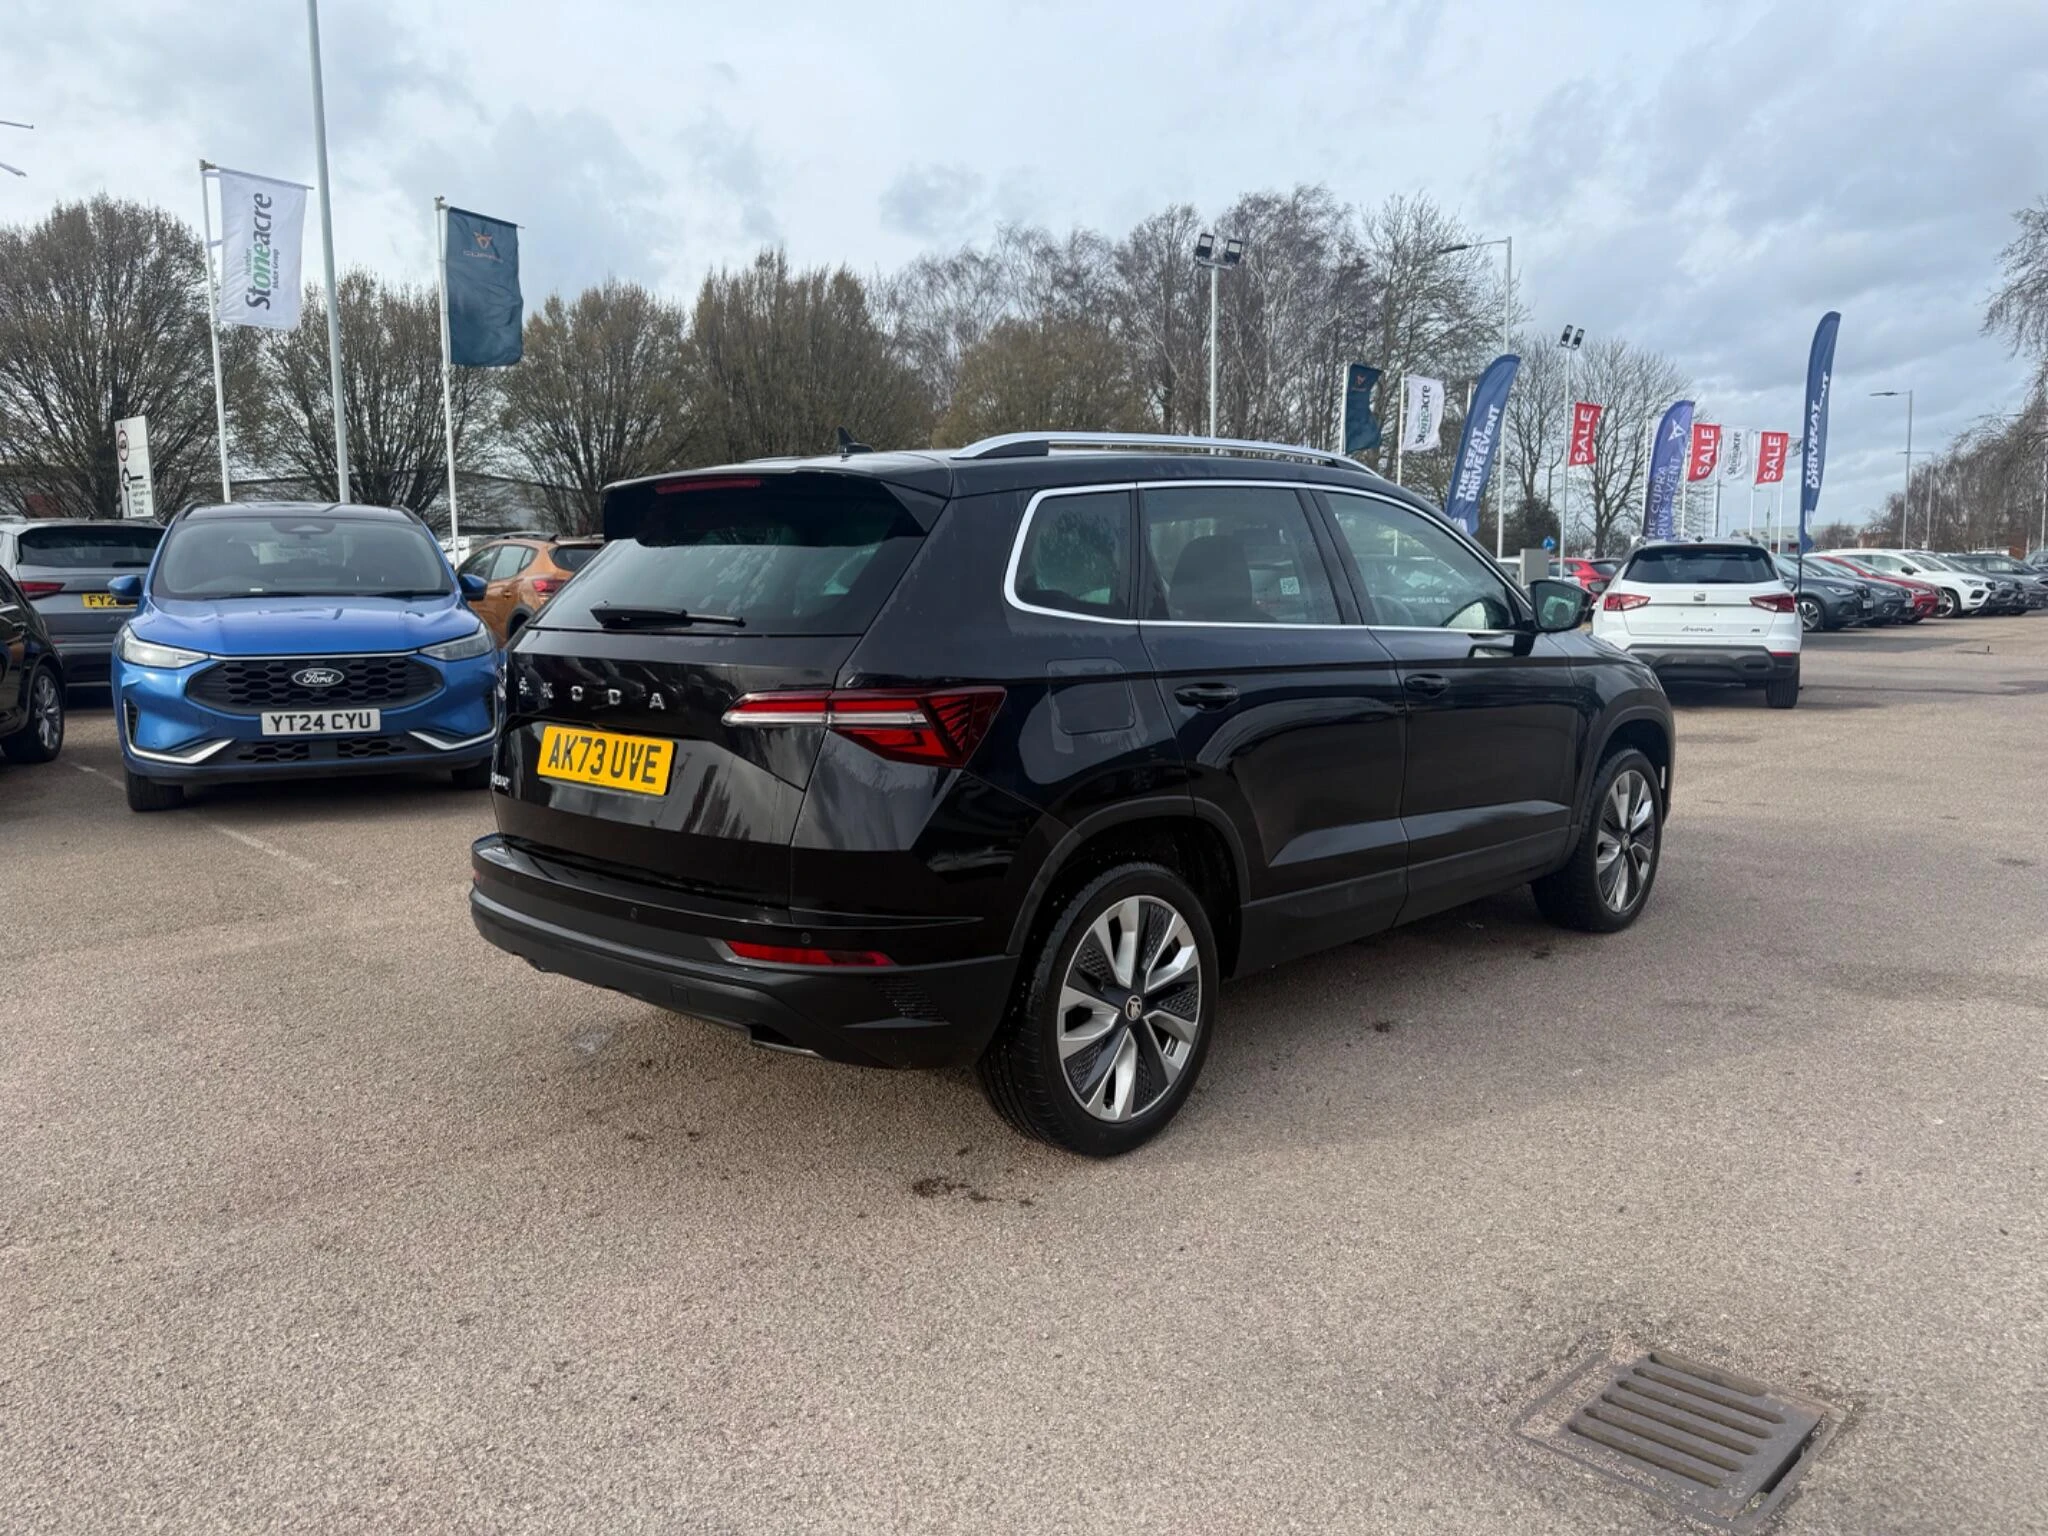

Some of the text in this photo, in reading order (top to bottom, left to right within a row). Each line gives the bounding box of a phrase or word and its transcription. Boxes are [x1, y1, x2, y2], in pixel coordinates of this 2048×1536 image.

[245, 192, 272, 310] Stoneacre
[1415, 384, 1431, 444] Stoneacre
[1575, 409, 1594, 463] SALE
[1455, 426, 1484, 500] THE SEAT
[1465, 404, 1500, 502] DRIVE EVENT
[1697, 428, 1716, 476] SALE
[1764, 435, 1781, 481] SALE
[1650, 465, 1667, 514] CUPRA
[1663, 455, 1681, 503] EVENT
[303, 671, 334, 684] Ford
[271, 712, 371, 732] YT24 CYU
[548, 733, 662, 784] AK73 UVE
